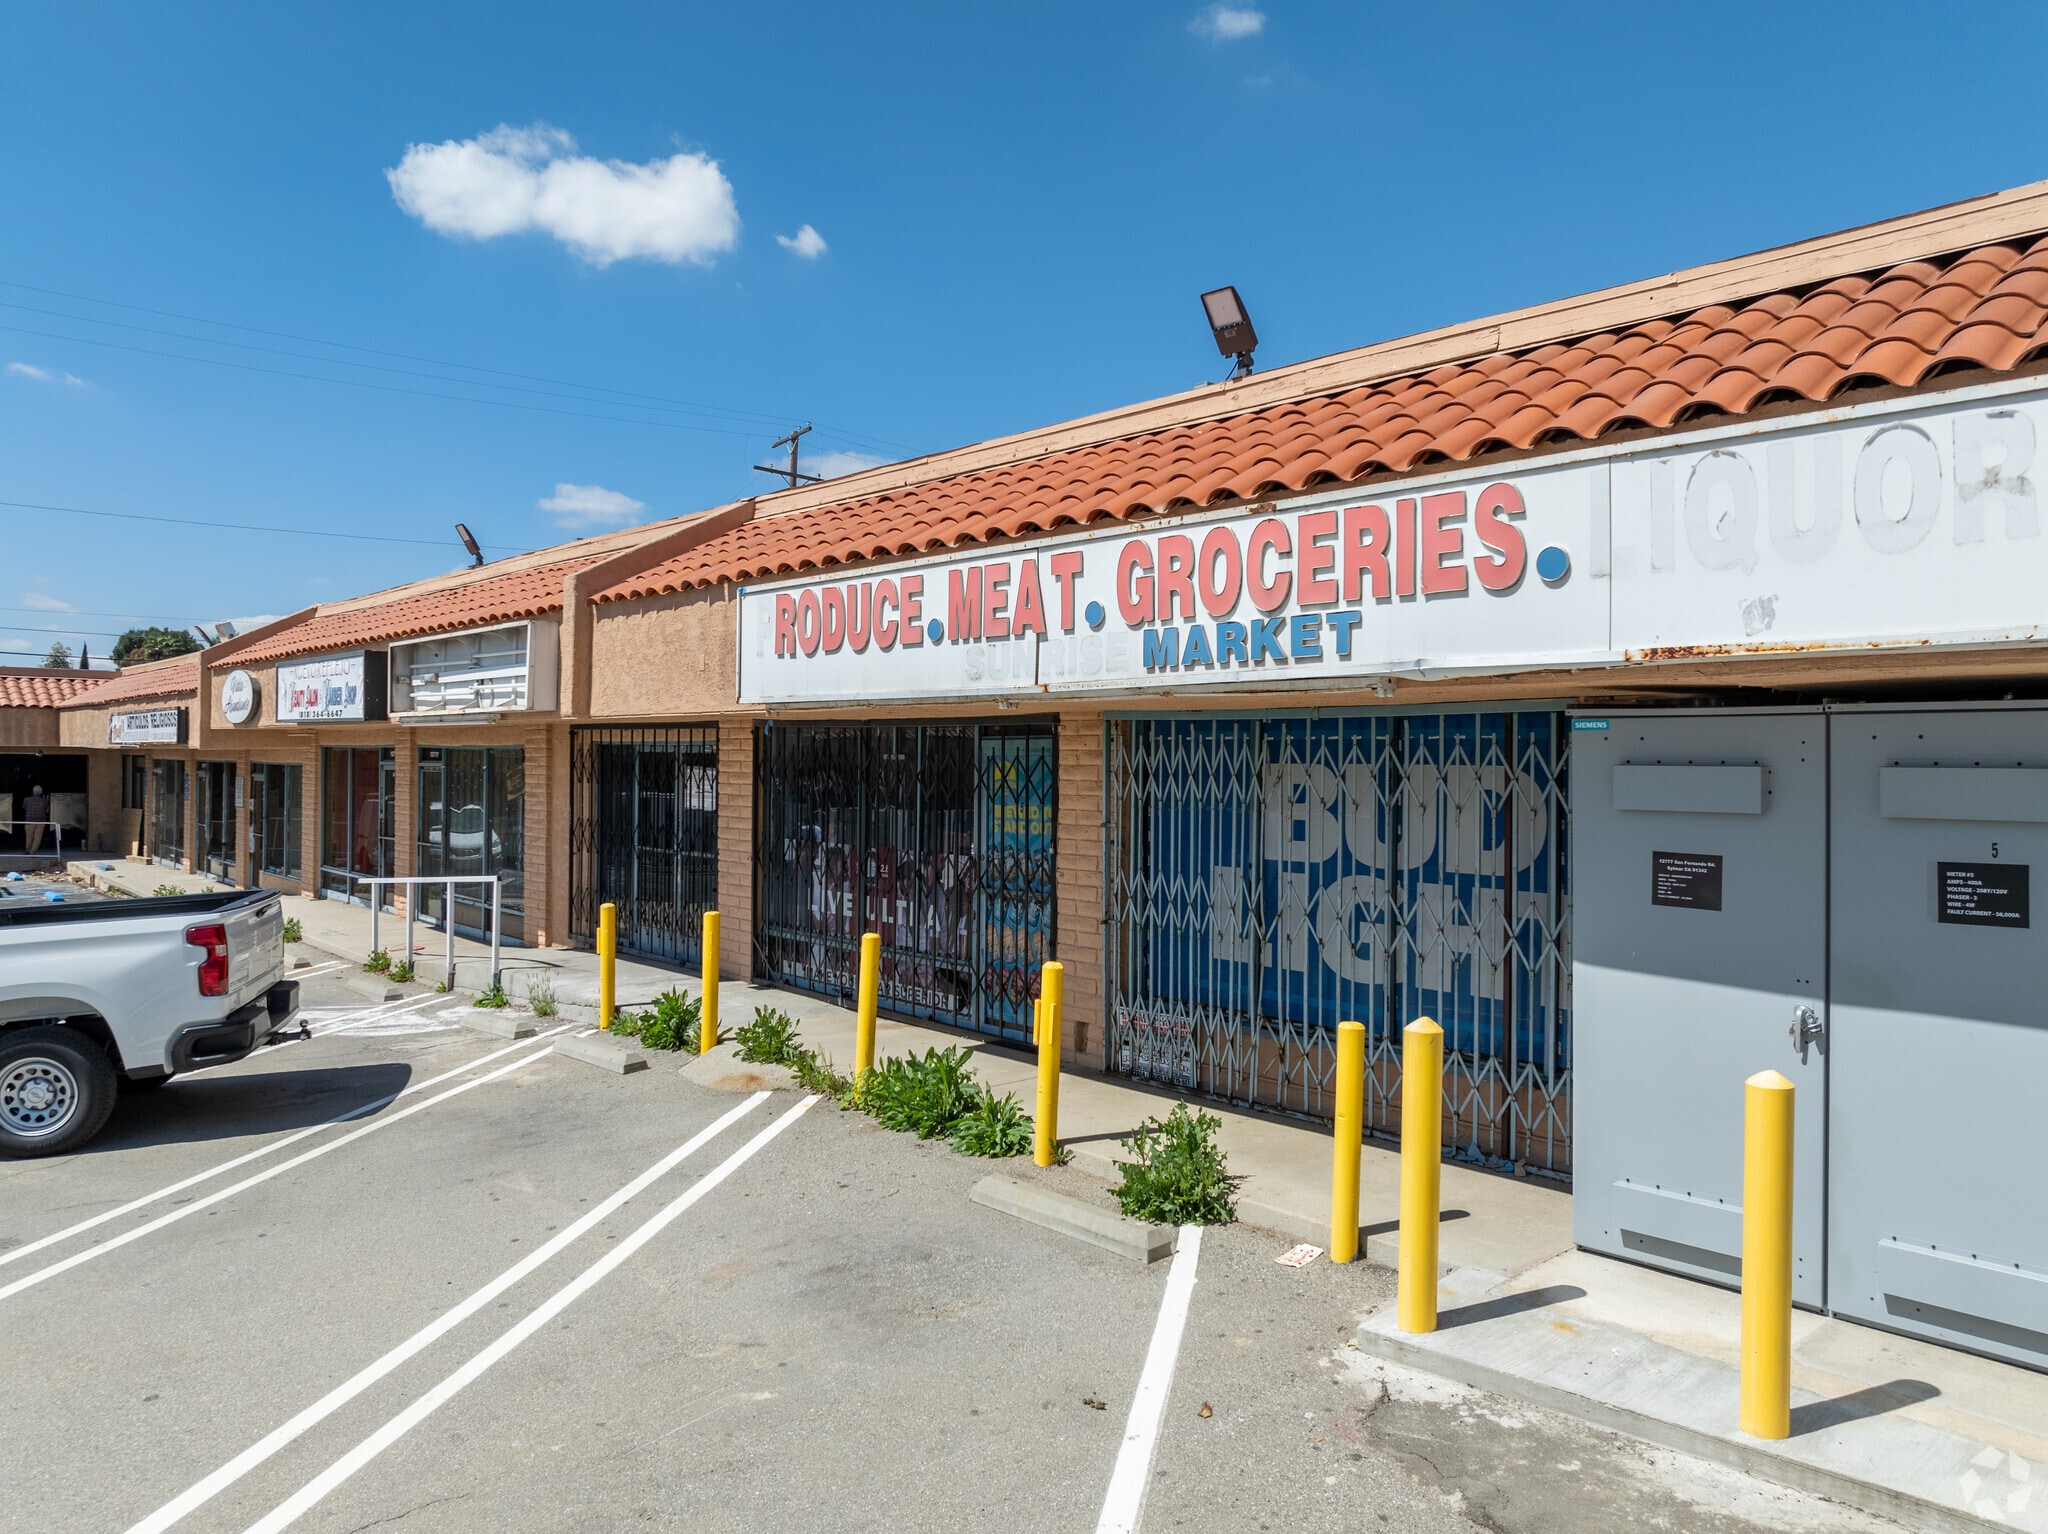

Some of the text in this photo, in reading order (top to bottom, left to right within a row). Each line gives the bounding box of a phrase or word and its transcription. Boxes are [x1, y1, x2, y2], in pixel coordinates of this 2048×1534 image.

[1143, 610, 1361, 668] MARKET
[312, 710, 343, 718] 364-6647
[1574, 721, 1607, 729] SIEMENS
[1264, 763, 1548, 877] BUD
[1991, 842, 1998, 858] 5
